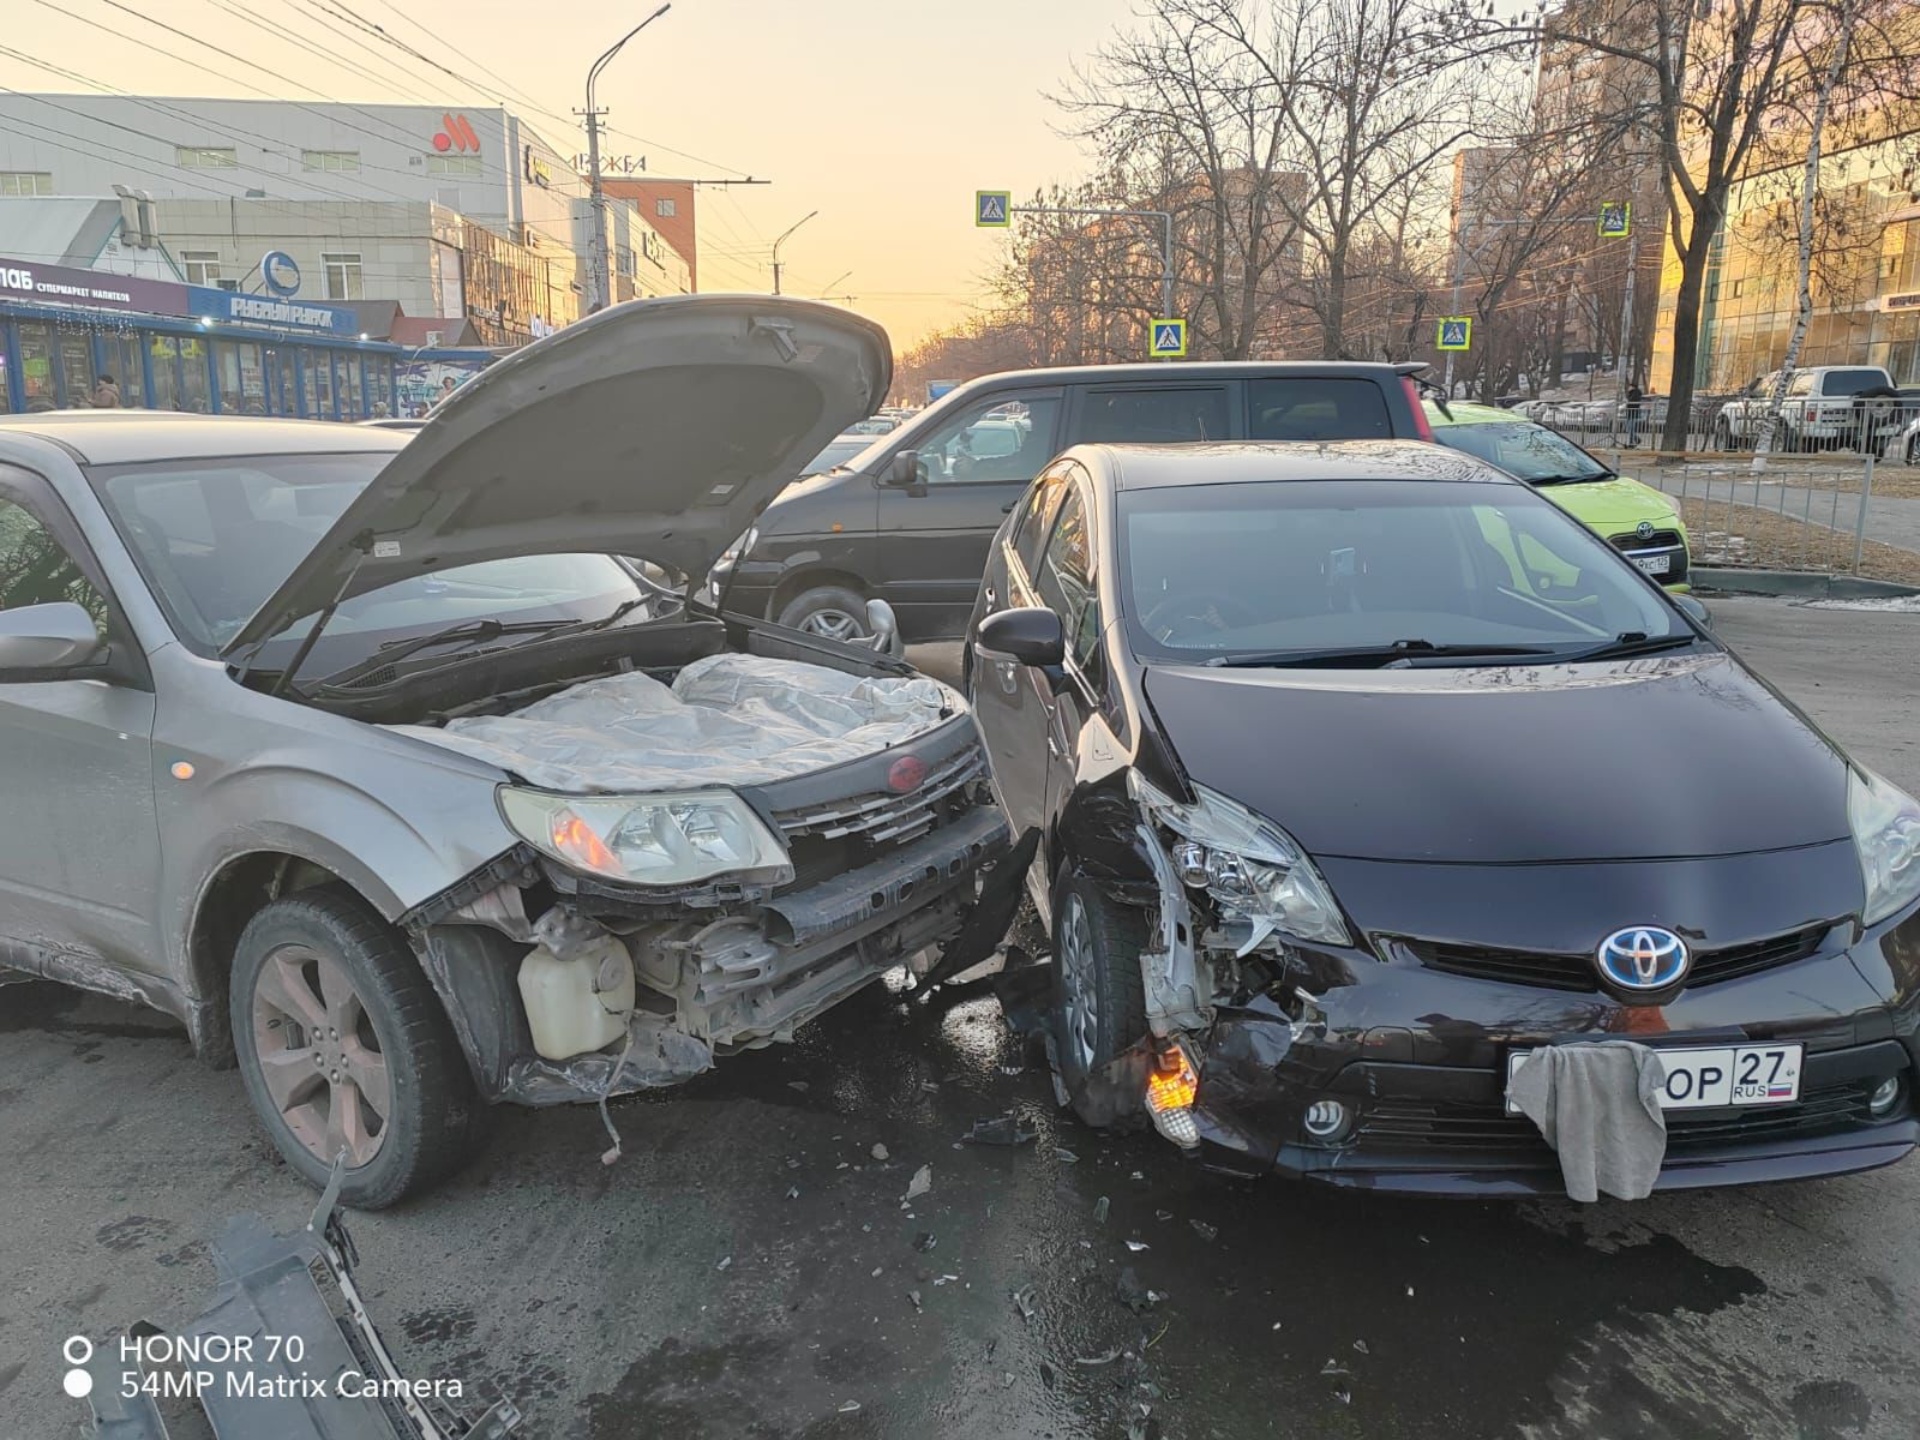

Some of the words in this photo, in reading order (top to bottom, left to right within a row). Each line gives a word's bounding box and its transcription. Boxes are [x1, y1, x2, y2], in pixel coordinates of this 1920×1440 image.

[37, 282, 90, 298] СУПЕРМАРКЕТ
[92, 289, 131, 302] НАПИТКОВ
[230, 297, 289, 323] РЫБНЫЙ
[290, 305, 333, 329] РЫНОК
[1739, 1052, 1785, 1085] 27
[1734, 1085, 1766, 1098] RUS
